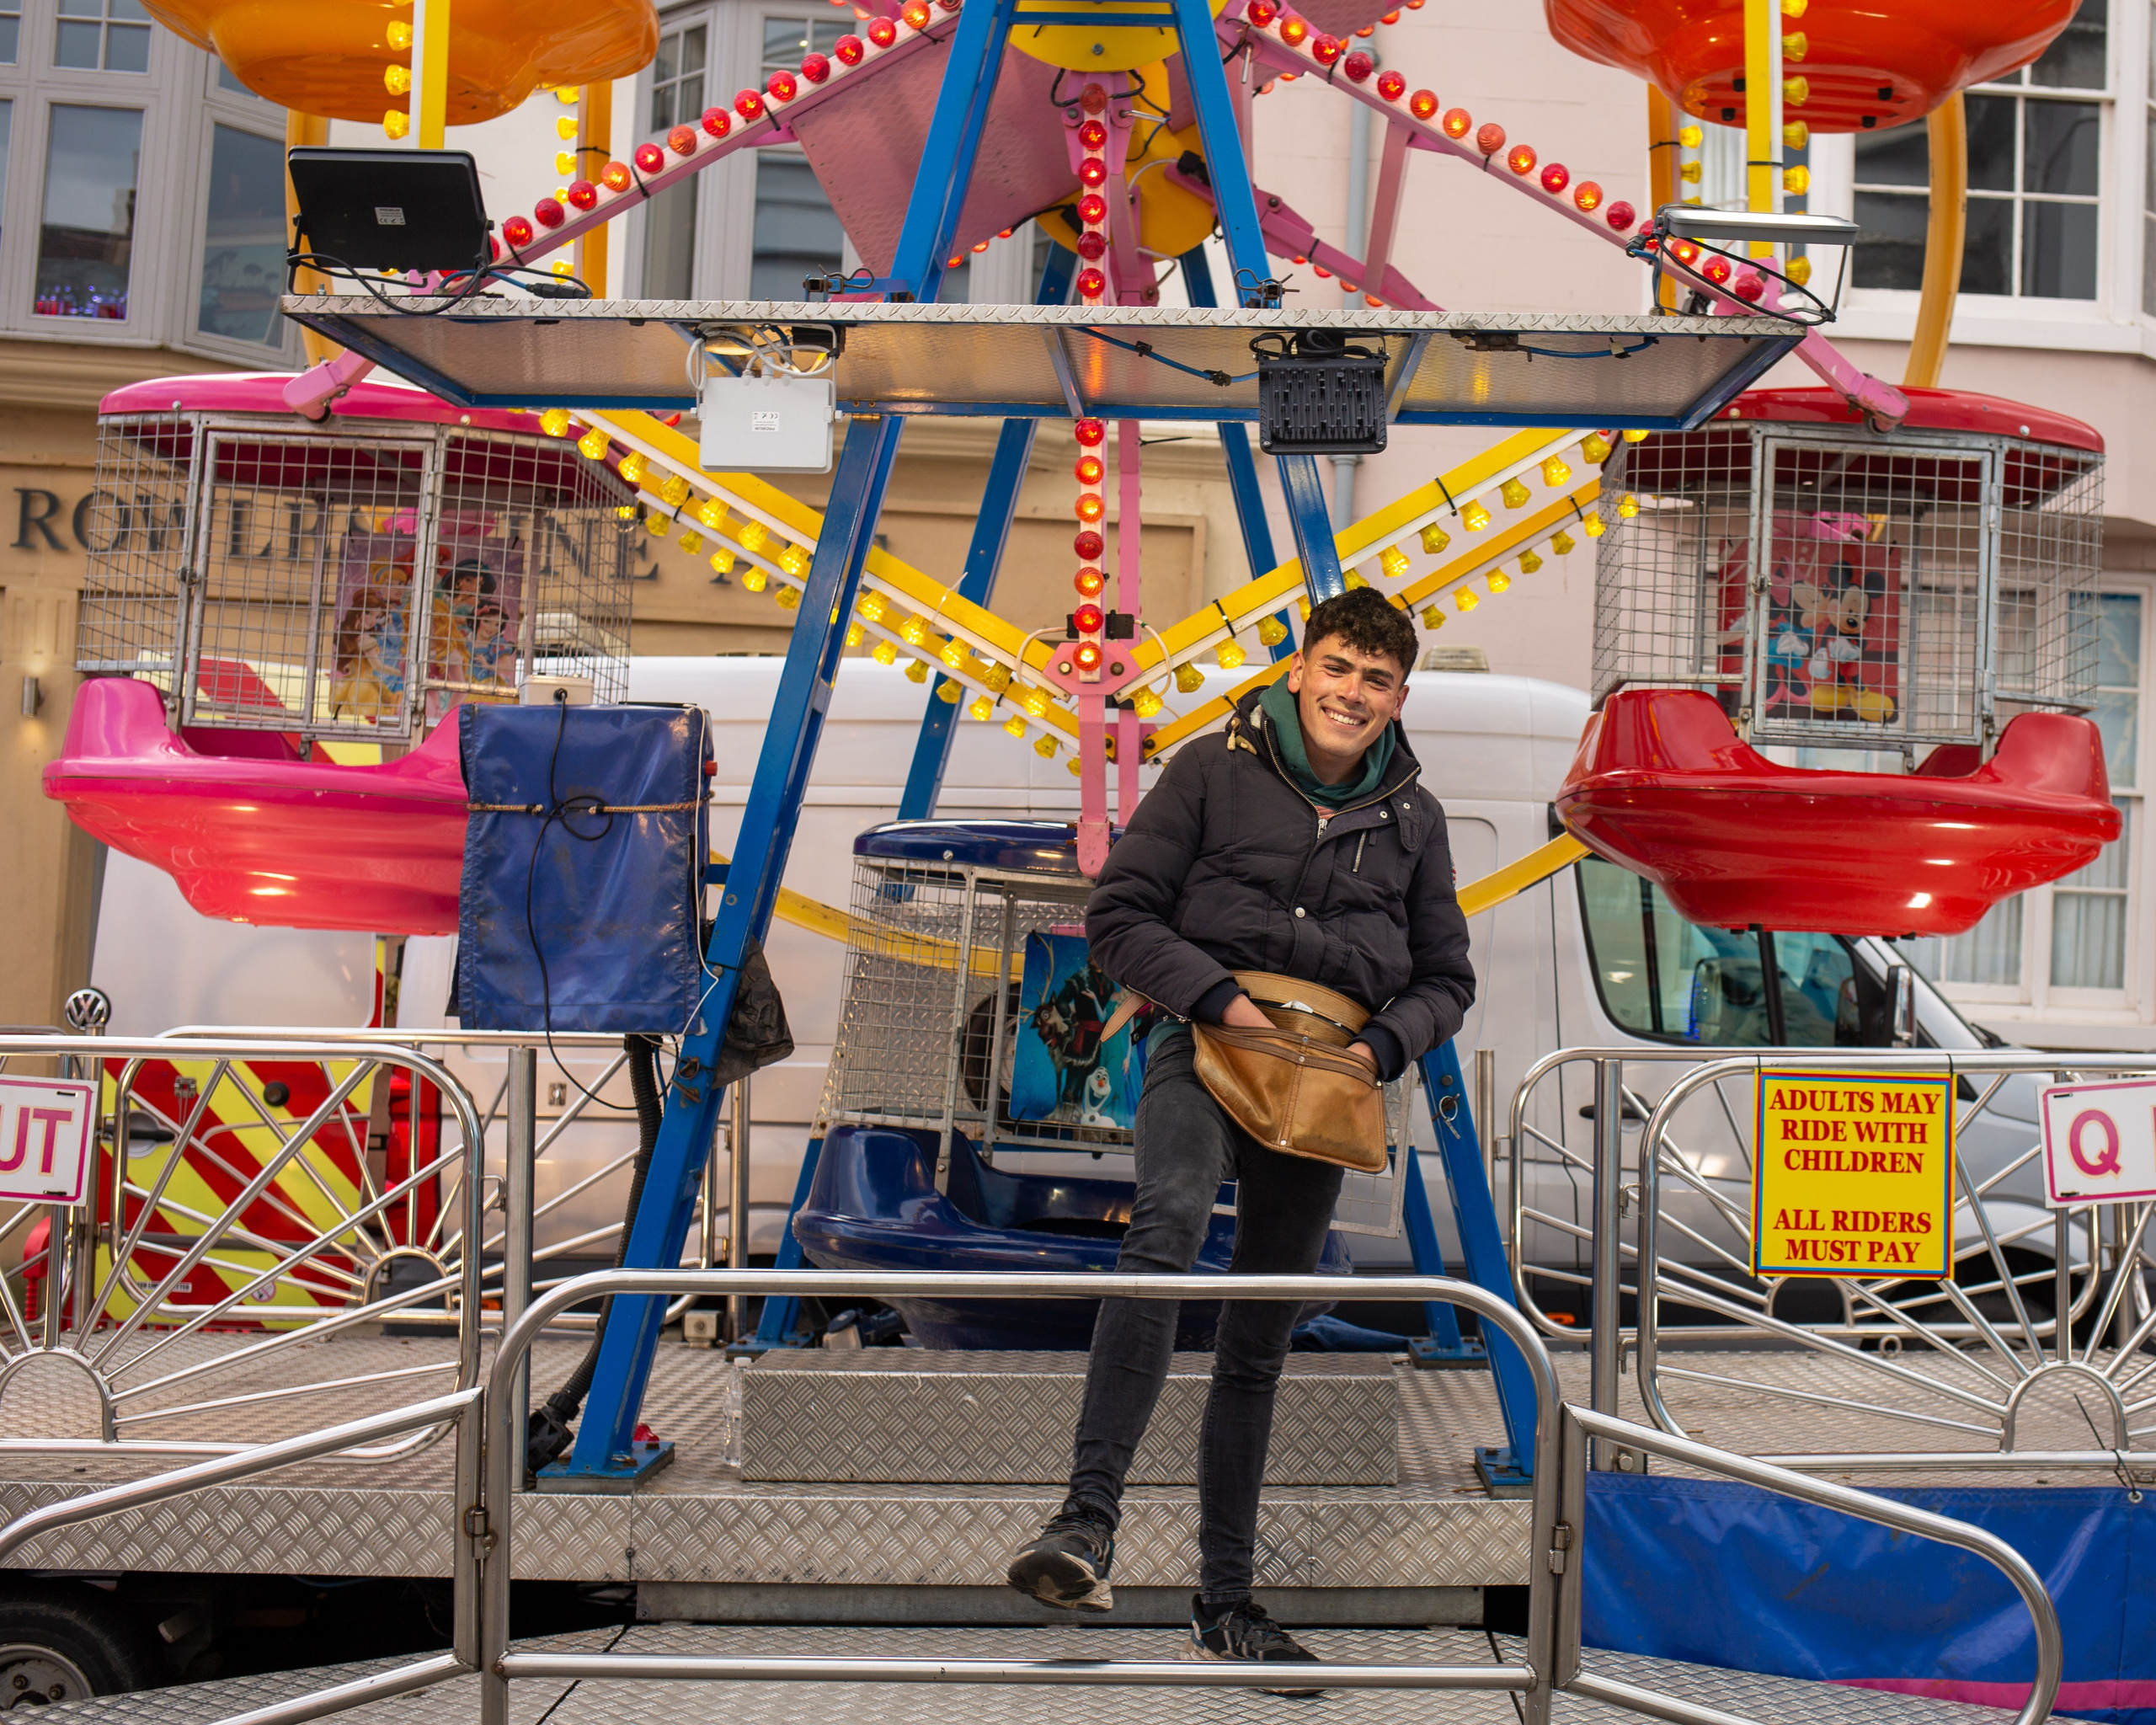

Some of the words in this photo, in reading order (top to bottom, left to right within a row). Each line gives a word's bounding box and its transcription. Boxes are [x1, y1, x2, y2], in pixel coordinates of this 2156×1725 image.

[1769, 1088, 1875, 1114] ADULTS
[1880, 1092, 1941, 1114] MAY
[1780, 1119, 1848, 1142] RIDE
[1852, 1121, 1929, 1144] WITH
[2067, 1108, 2125, 1181] Q
[1784, 1149, 1924, 1174] CHILDREN
[1773, 1209, 1826, 1231] ALL
[1830, 1210, 1932, 1234] RIDERS
[1785, 1239, 1861, 1262] MUST
[1866, 1241, 1921, 1263] PAY
